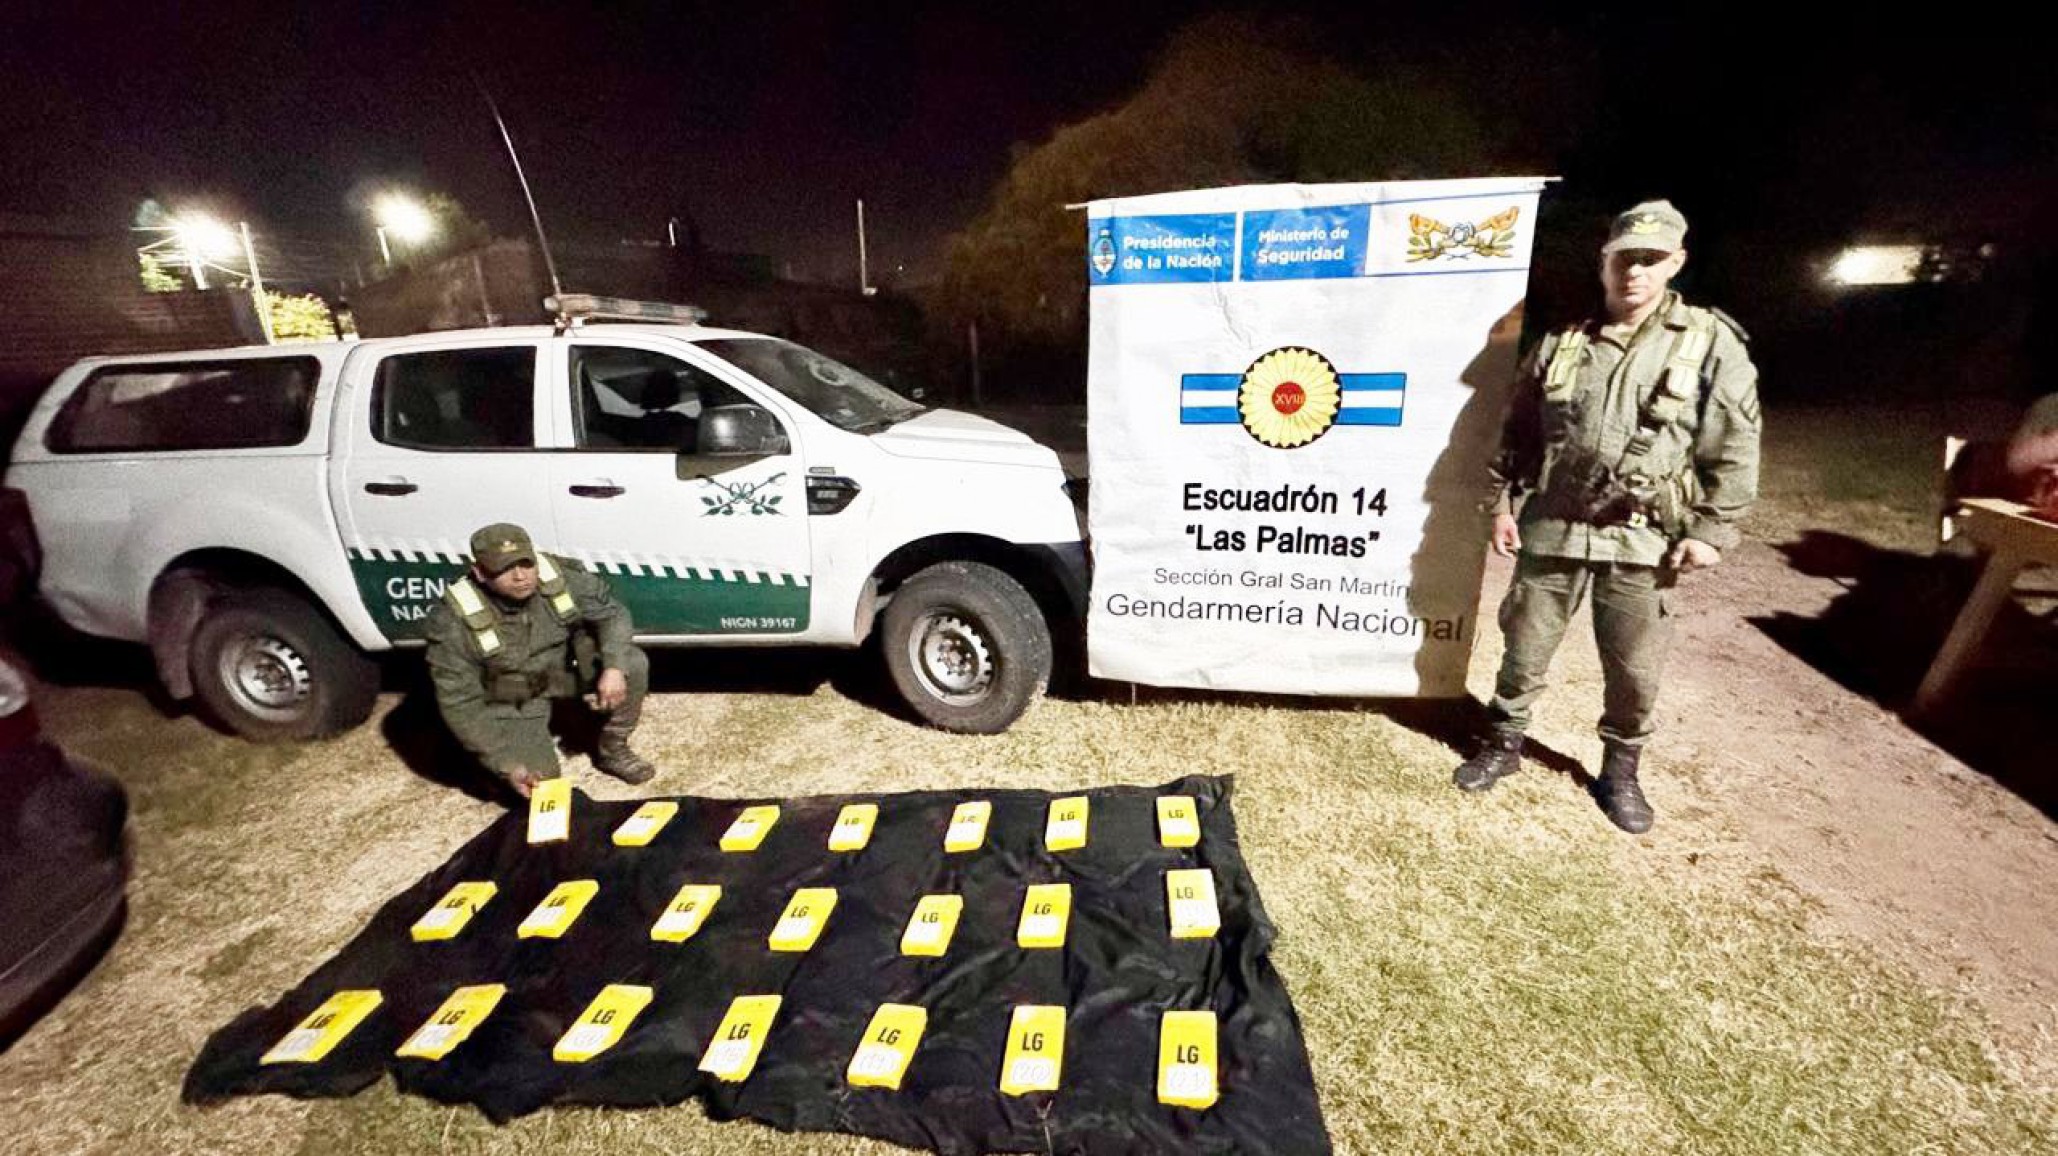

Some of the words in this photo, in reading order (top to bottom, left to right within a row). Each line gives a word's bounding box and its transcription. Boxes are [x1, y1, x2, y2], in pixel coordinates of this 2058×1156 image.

[1123, 233, 1217, 250] Presidencia
[1258, 227, 1326, 244] Ministerio
[1330, 226, 1350, 240] de
[1123, 254, 1143, 270] de
[1147, 254, 1162, 269] la
[1166, 252, 1223, 268] Nación
[1257, 244, 1346, 265] Seguridad
[1182, 482, 1339, 515] Escuadrón
[1351, 487, 1388, 517] 14
[385, 576, 446, 600] GEN
[1153, 566, 1234, 588] Sección
[1239, 570, 1284, 590] Gral
[1290, 572, 1332, 593] San
[1339, 575, 1412, 598] Martín
[1105, 592, 1304, 627] Gendarmería
[1315, 602, 1465, 642] Nacional
[539, 800, 556, 814] LG
[1175, 886, 1194, 899] LG
[789, 905, 810, 918] LG
[921, 912, 940, 924] LG
[1033, 903, 1053, 915] LG
[437, 1009, 466, 1025] LG
[589, 1008, 617, 1025] LG
[727, 1023, 752, 1041] LG
[877, 1026, 901, 1046] LG
[1022, 1031, 1044, 1051] LG
[1176, 1043, 1200, 1065] LG
